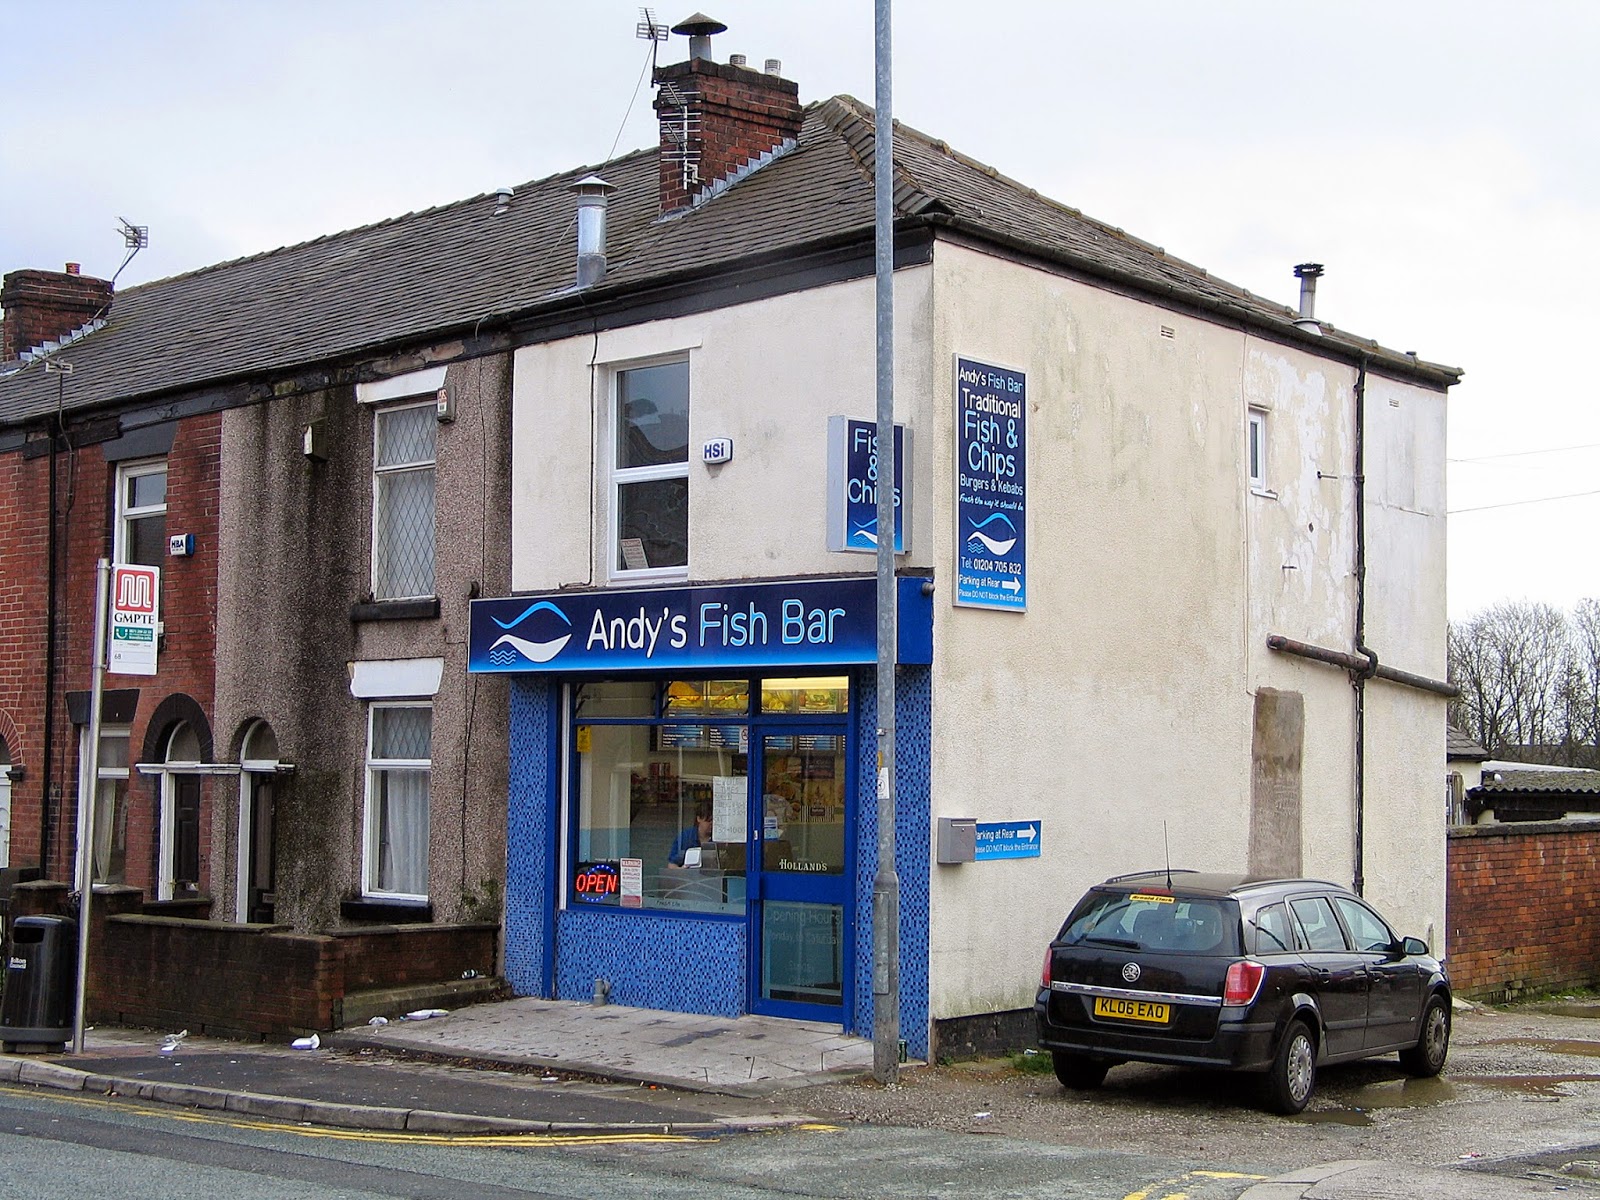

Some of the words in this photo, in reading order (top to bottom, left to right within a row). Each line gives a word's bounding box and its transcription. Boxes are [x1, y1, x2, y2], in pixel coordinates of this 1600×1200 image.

[959, 367, 986, 387] Andy's
[988, 373, 1005, 390] Fish
[1008, 378, 1023, 393] Bar
[962, 387, 1021, 419] Traditional
[965, 410, 1000, 444] Fish
[1006, 419, 1018, 448] &
[704, 443, 724, 459] HSi
[854, 428, 877, 454] Fis
[968, 441, 1016, 480] Chips
[847, 478, 901, 507] Chis
[960, 473, 989, 492] Burgers
[990, 479, 997, 491] &
[998, 480, 1024, 496] Kebabs
[973, 558, 993, 571] 01204
[994, 560, 1008, 573] 705
[1008, 562, 1022, 575] 832
[959, 574, 979, 588] Parking
[980, 577, 987, 587] at
[987, 577, 1000, 588] Rear
[114, 612, 154, 624] GMPTE
[586, 606, 688, 658] Andy's
[699, 601, 768, 648] Fish
[781, 598, 847, 645] Bar
[975, 830, 994, 842] arking
[995, 829, 1001, 839] at
[1001, 829, 1015, 839] Rear
[576, 874, 617, 892] OPEN
[1100, 999, 1134, 1014] KL06
[1138, 1003, 1164, 1018] EAO
